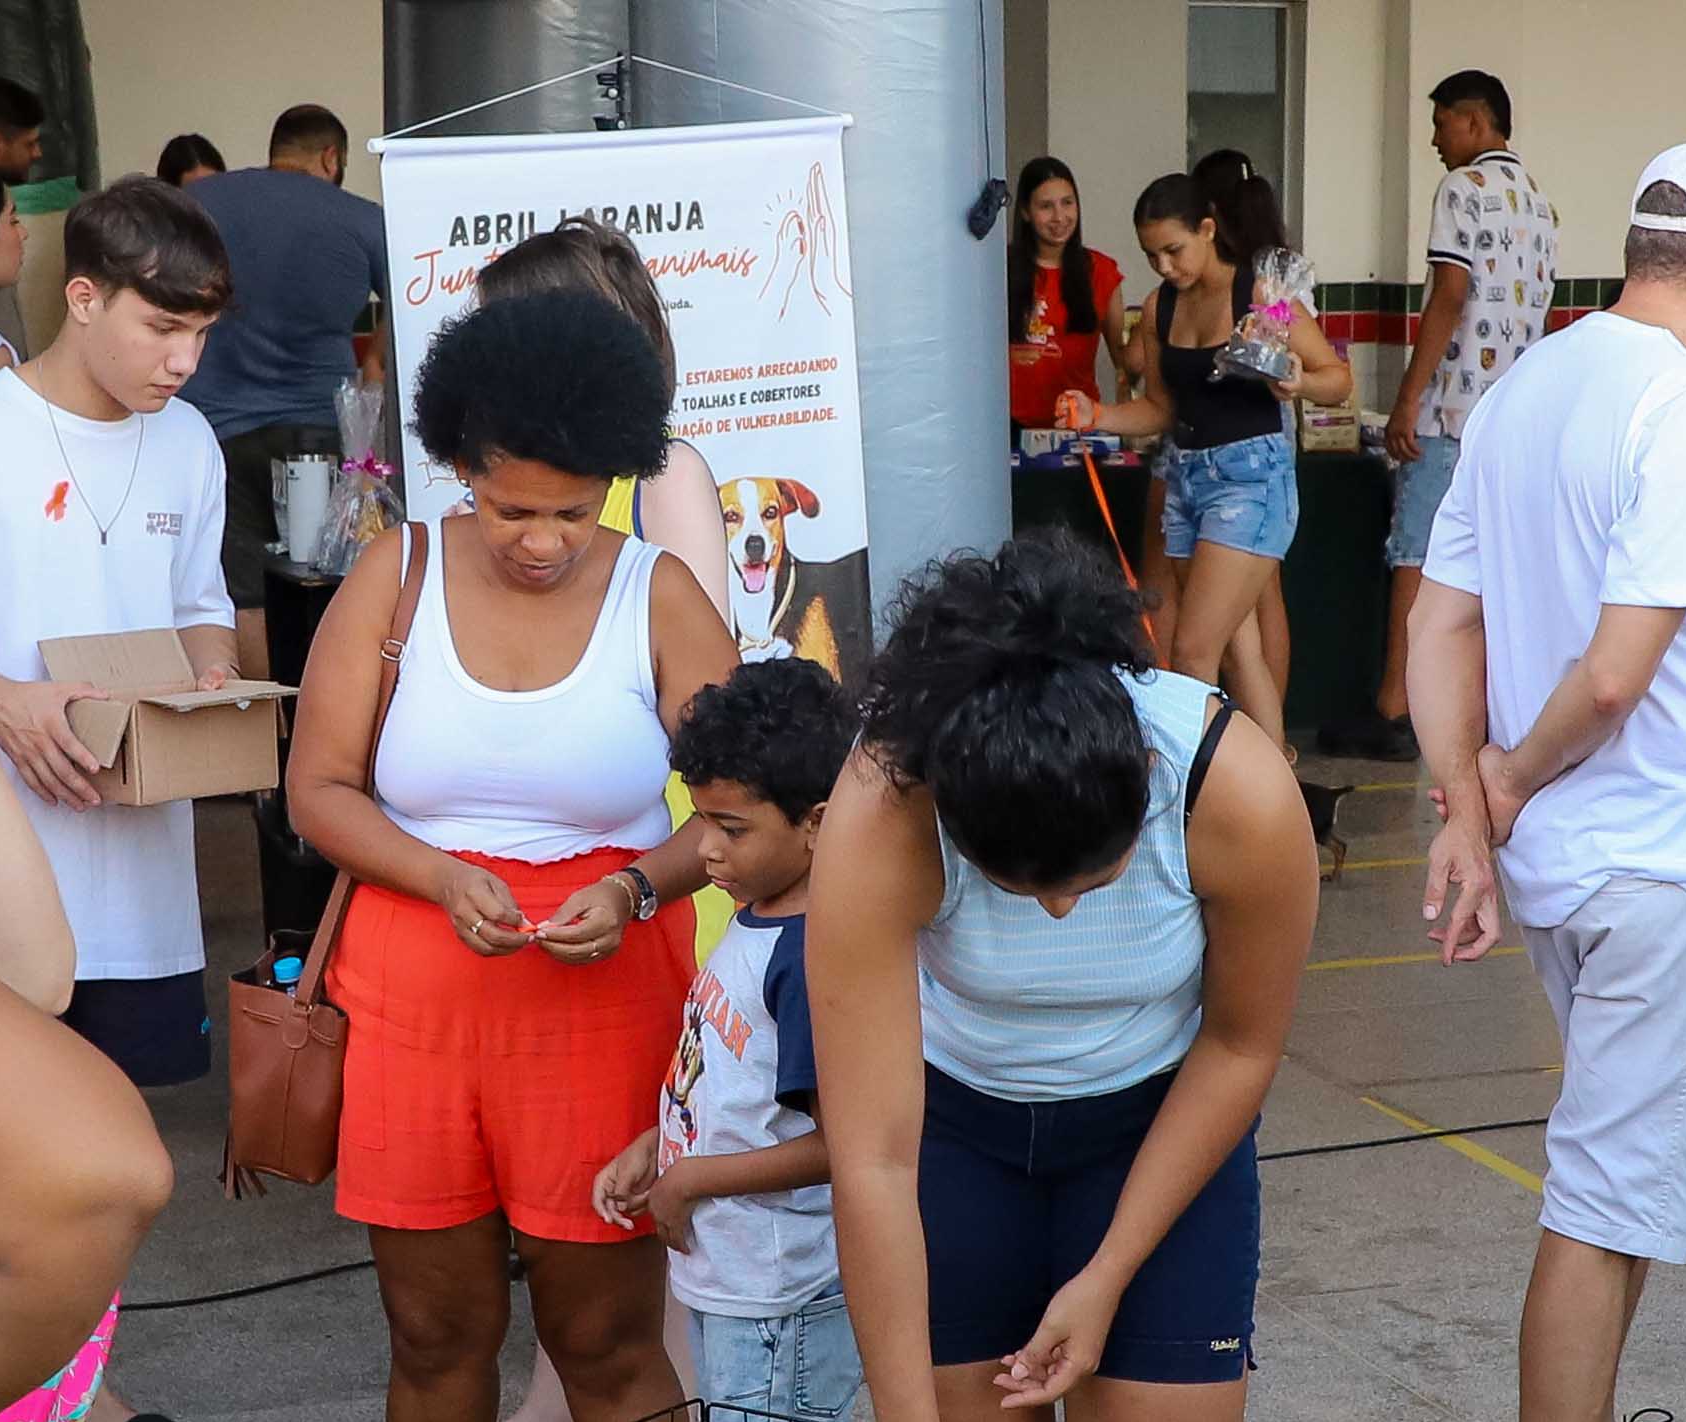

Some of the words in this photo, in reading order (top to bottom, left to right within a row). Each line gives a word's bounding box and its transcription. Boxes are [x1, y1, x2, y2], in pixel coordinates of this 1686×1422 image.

[685, 366, 754, 386] ESTAREMOS
[757, 357, 838, 379] ARRECADANDO
[681, 393, 736, 412] TOALHAS
[739, 392, 747, 405] E
[750, 384, 821, 404] COBERTORES
[716, 418, 732, 433] DE
